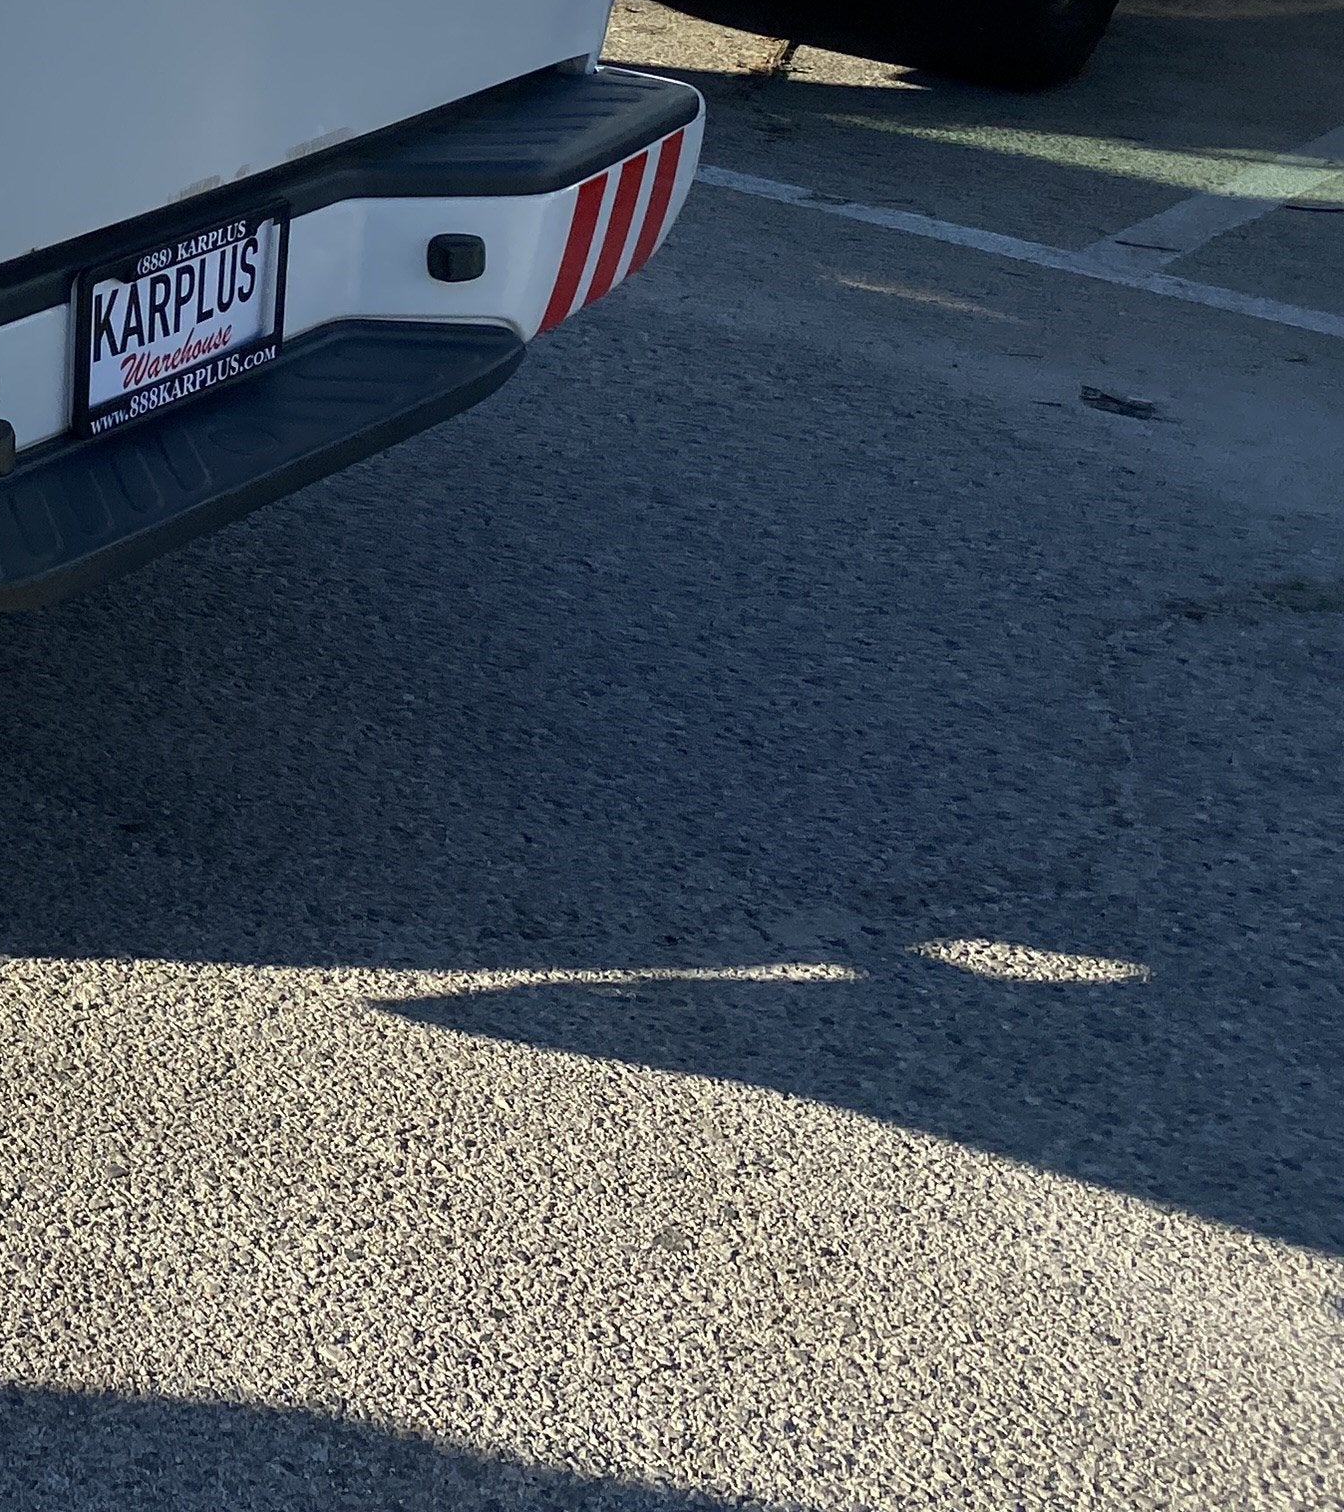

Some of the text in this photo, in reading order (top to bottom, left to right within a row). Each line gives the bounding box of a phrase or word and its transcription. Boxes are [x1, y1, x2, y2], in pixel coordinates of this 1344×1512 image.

[136, 220, 247, 276] (888) KARPLUS
[92, 235, 260, 363] KARPLUS
[120, 323, 233, 390] Warehouse
